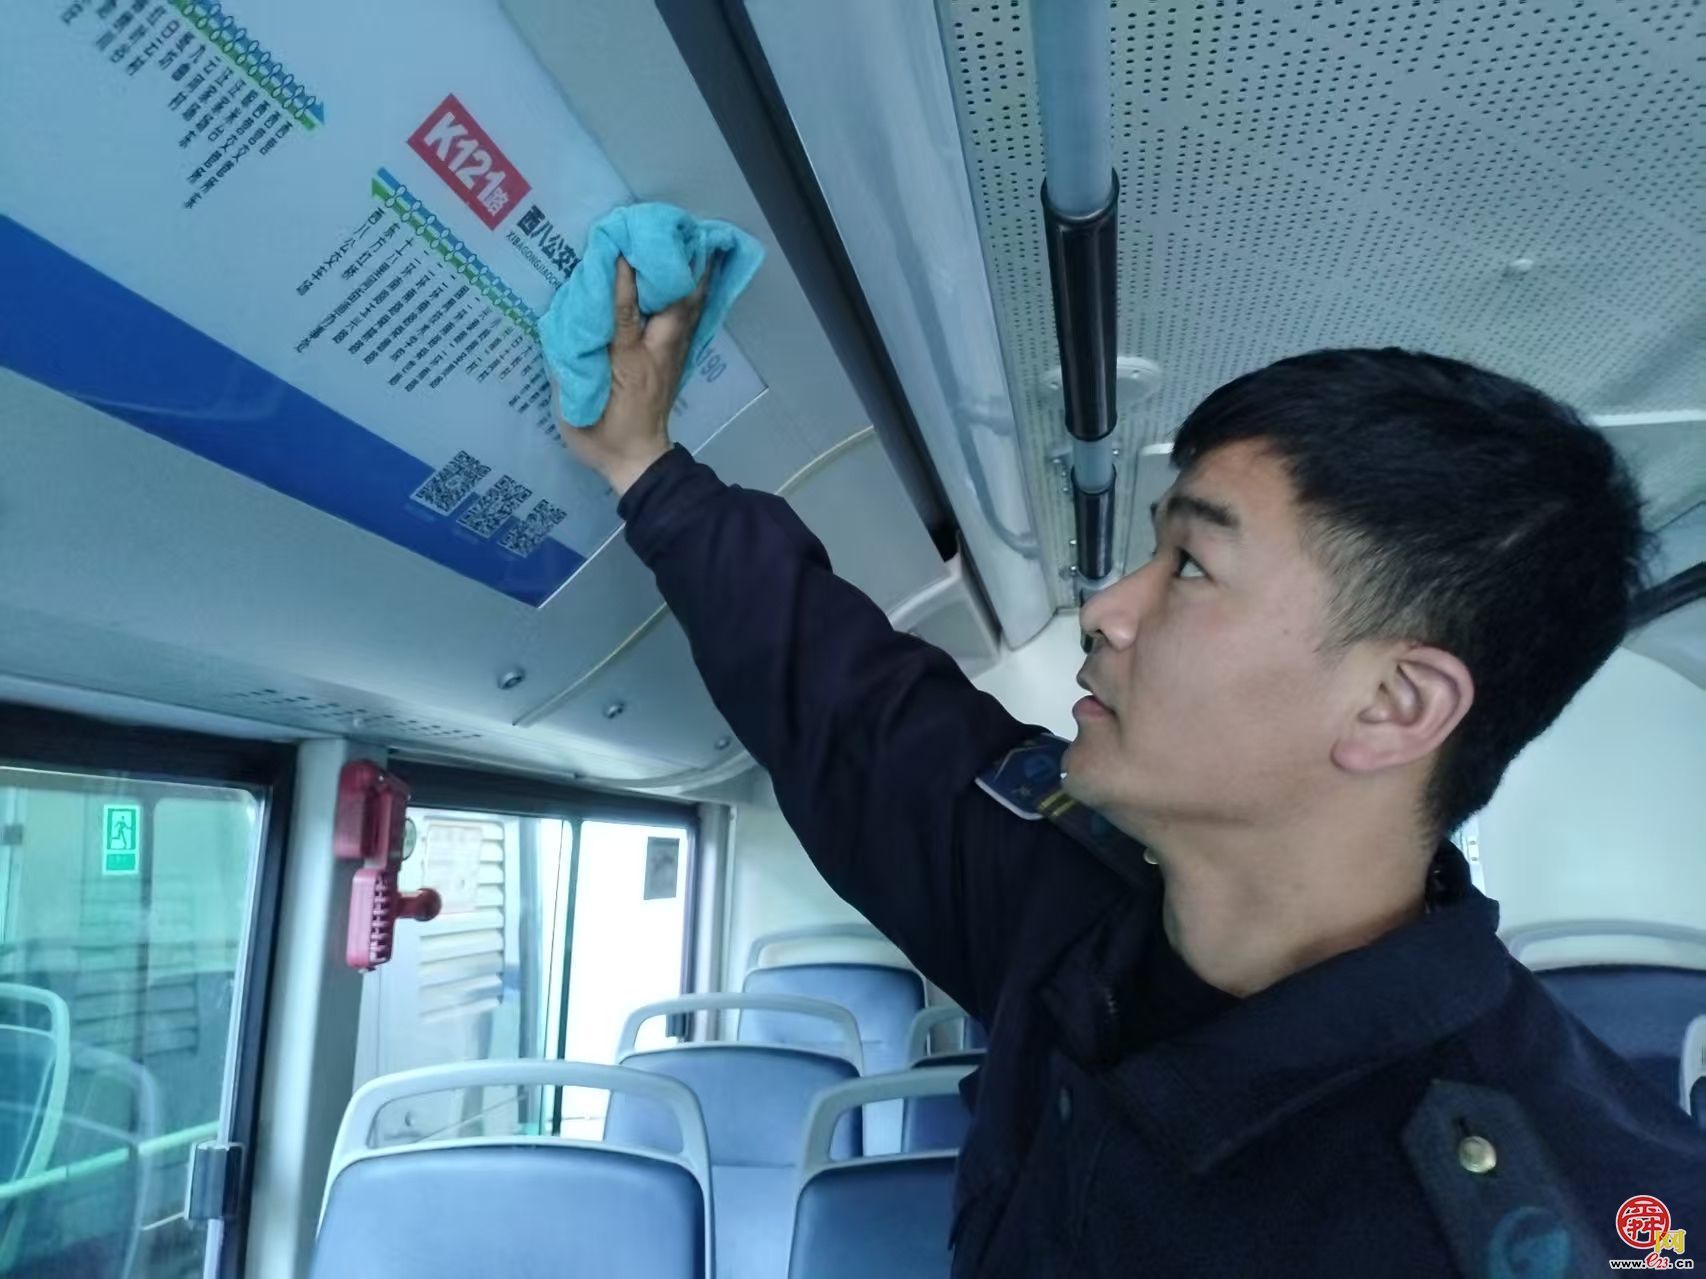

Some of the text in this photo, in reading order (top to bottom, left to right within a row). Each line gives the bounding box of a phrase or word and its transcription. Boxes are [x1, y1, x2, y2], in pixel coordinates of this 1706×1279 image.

[123, 16, 182, 78] 白云村
[182, 109, 282, 211] 西营交管所东
[186, 99, 271, 185] 西营交管所
[258, 119, 294, 156] 西营
[420, 109, 521, 216] K121路
[295, 206, 386, 296] 西八公交车场
[340, 221, 401, 282] 东方红桥
